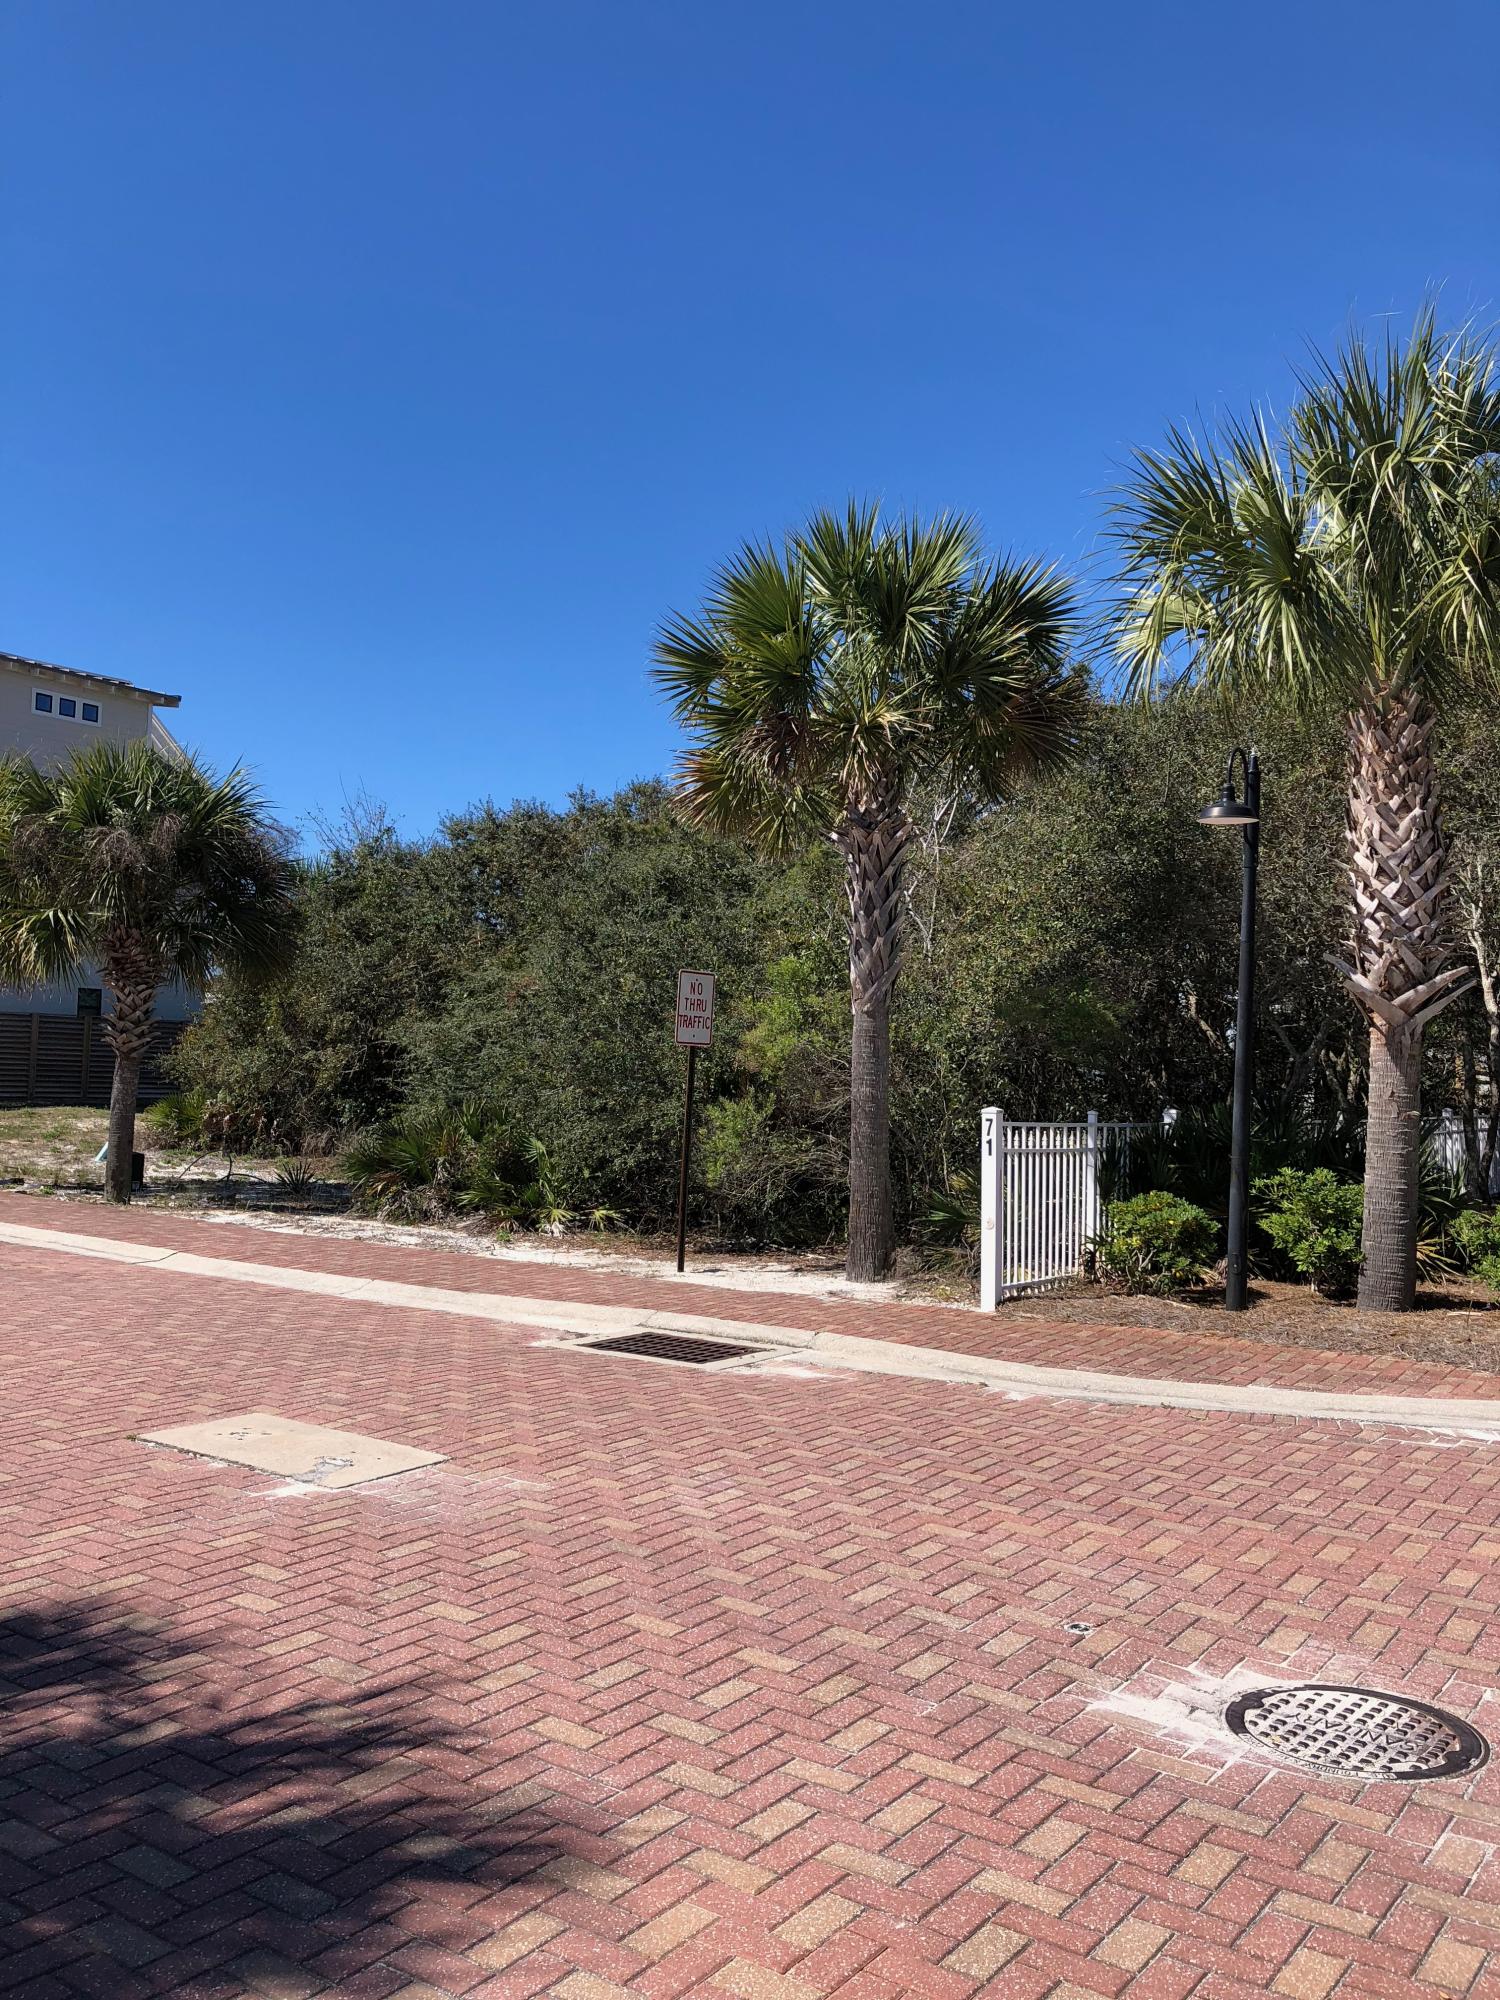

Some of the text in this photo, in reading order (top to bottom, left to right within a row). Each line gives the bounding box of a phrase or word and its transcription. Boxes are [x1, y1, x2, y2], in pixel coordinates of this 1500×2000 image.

[690, 982, 703, 995] NO
[684, 997, 707, 1012] THRU
[679, 1014, 710, 1029] TRAFFIC
[1284, 1712, 1420, 1752] SANITARY
